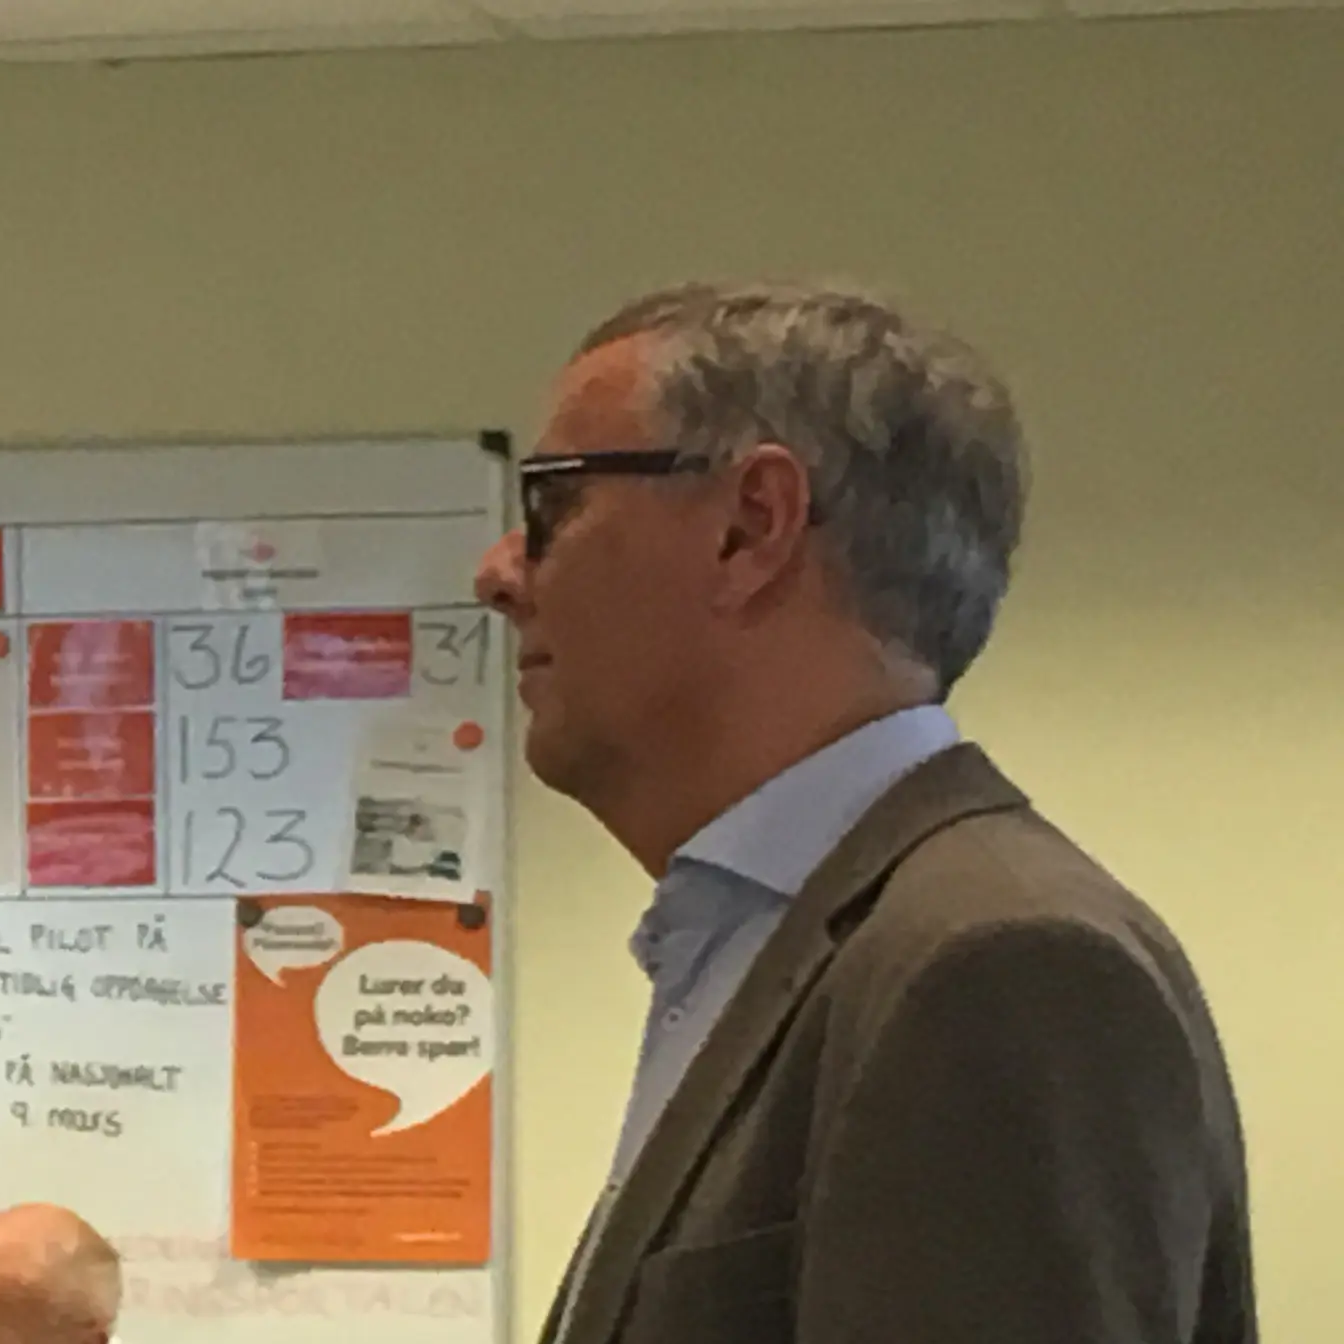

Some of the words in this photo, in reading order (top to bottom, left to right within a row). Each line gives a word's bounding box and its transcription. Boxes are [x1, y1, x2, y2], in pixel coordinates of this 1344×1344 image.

[172, 624, 270, 690] 36
[417, 613, 490, 686] 31
[179, 714, 290, 784] 153
[182, 805, 316, 888] 123
[30, 923, 113, 953] PILOT
[136, 913, 169, 952] PÅ
[358, 973, 426, 997] Lurer
[431, 973, 467, 997] du
[354, 1004, 387, 1031] på
[391, 1003, 471, 1028] noko?
[5, 1053, 35, 1087] PÅ
[50, 1061, 183, 1092] NASJONALT
[9, 1100, 31, 1128] 9
